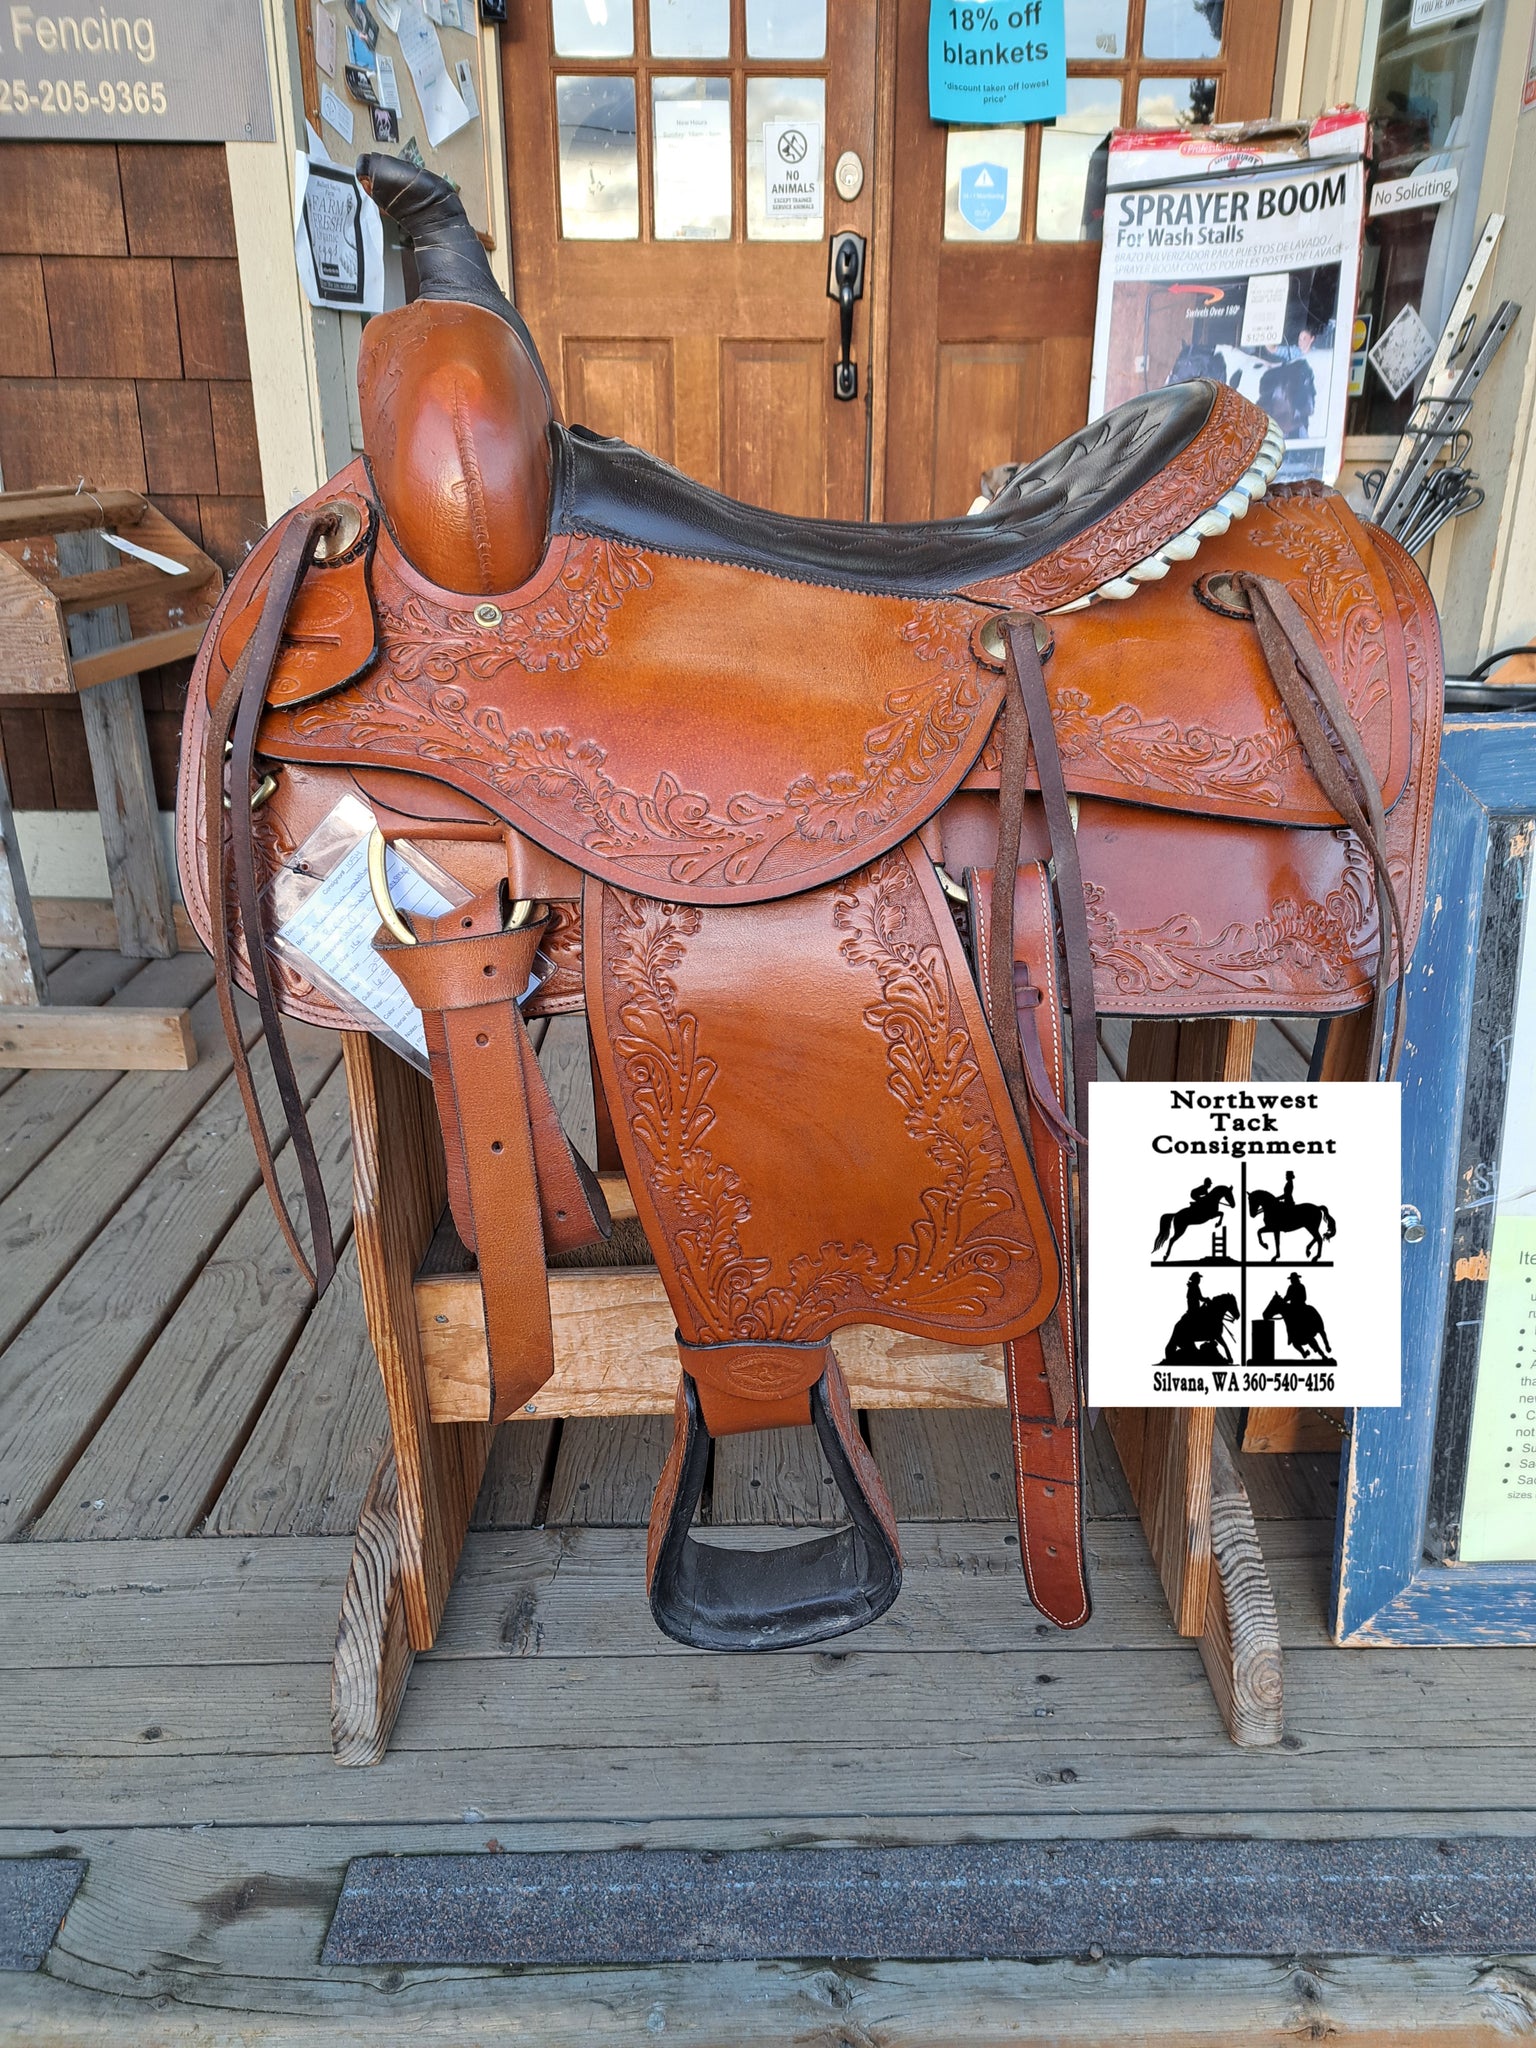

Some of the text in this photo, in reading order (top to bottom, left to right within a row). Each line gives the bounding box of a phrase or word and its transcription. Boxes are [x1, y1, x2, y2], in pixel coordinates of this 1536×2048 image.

[949, 1, 1042, 31] 18% off
[10, 6, 156, 63] Fencing
[944, 40, 1048, 65] blankets
[983, 84, 1005, 92] taken
[1008, 82, 1019, 90] off
[1022, 79, 1049, 89] lowest
[786, 170, 799, 181] NO
[771, 182, 815, 194] ANIMALS
[1374, 180, 1451, 206] No Soliciting
[312, 194, 345, 217] FARM
[1118, 173, 1346, 227] SPRAYER BOOM
[312, 212, 343, 233] FRESH
[1116, 224, 1244, 248] For Wash Stalls
[1115, 251, 1144, 263] BRAZO
[1145, 249, 1209, 262] PULVERIZADOR
[1211, 248, 1234, 259] PARA
[1236, 243, 1274, 257] PUESTOS
[1276, 242, 1288, 252] DE
[1290, 235, 1327, 250] LAVADO
[1114, 263, 1149, 274] SPRAYER
[1151, 262, 1180, 273] BOOM
[1219, 258, 1243, 270] POUR
[1245, 258, 1259, 268] LES
[1261, 253, 1293, 267] POSTES
[1295, 252, 1307, 262] DE
[1185, 307, 1209, 319] Swivels
[1209, 306, 1224, 317] Over
[1515, 1427, 1535, 1437] not
[1507, 1490, 1532, 1499] sizes
